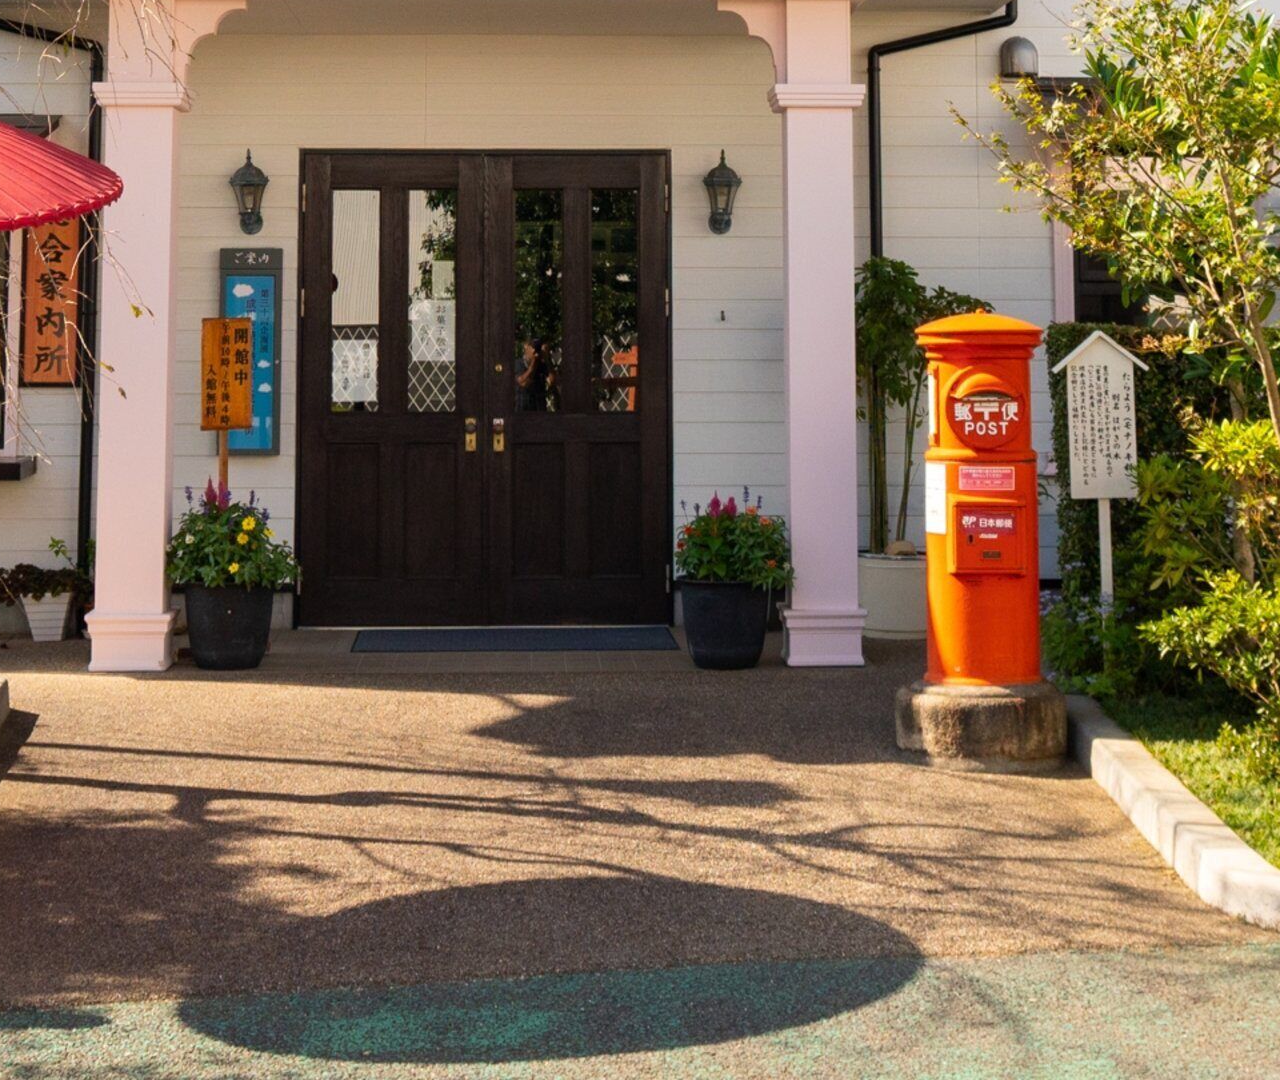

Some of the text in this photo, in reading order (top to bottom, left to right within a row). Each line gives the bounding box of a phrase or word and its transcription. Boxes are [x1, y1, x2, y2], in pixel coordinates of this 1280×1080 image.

[234, 251, 270, 264] ご案内
[33, 219, 72, 377] 合案内所
[234, 328, 250, 386] 開館中
[205, 364, 218, 417] 入館無料
[964, 421, 1009, 435] POST
[979, 518, 1013, 528] 日本郵便
